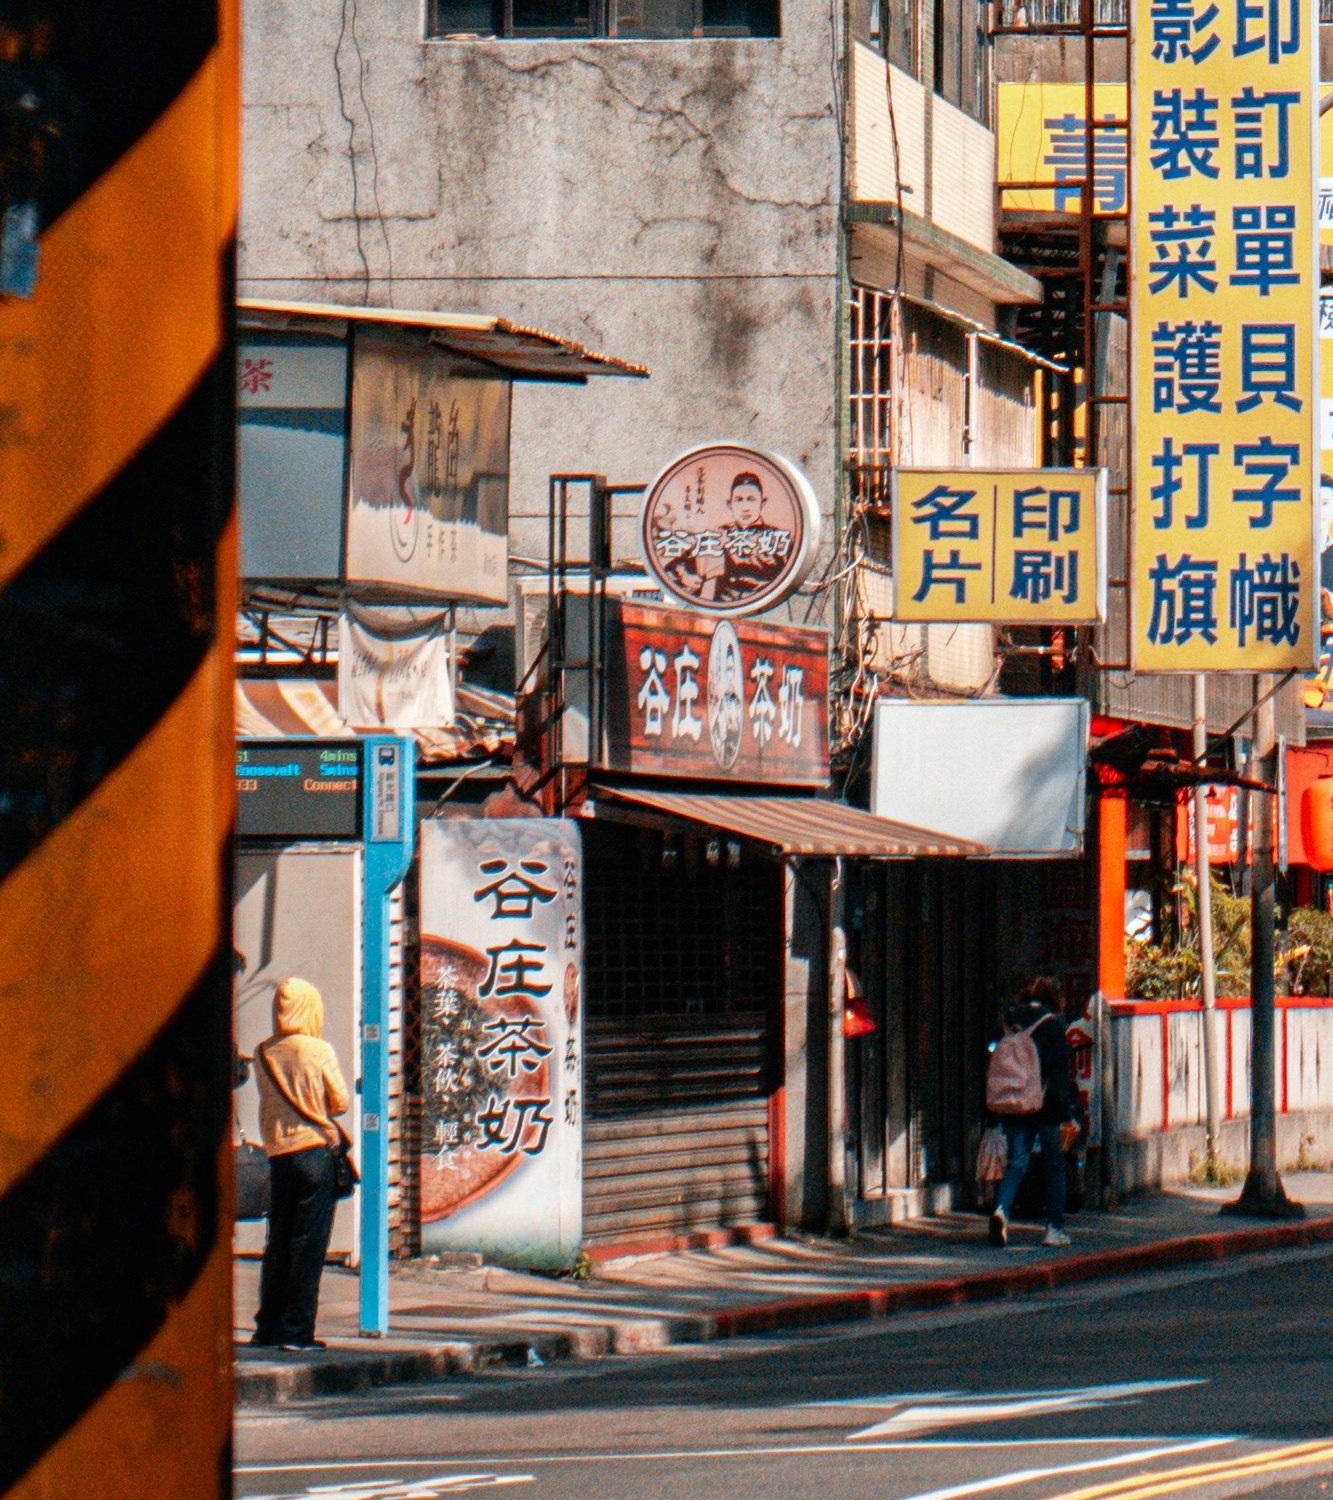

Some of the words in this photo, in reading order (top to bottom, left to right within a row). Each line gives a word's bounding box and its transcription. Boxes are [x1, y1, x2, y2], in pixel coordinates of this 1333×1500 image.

[1150, 86, 1301, 180] 裝訂
[1148, 204, 1301, 298] 菜單
[1150, 320, 1303, 415] 護貝
[1149, 435, 1301, 530] 打字
[656, 529, 791, 558] 谷庄茶奶
[1146, 552, 1301, 649] 旗幟
[638, 644, 702, 738] 谷庄
[749, 656, 804, 749] 茶奶
[303, 778, 357, 792] Connect
[319, 749, 357, 763] 4mins
[319, 764, 359, 777] 5mins
[473, 859, 559, 1157] 谷庄茶奶
